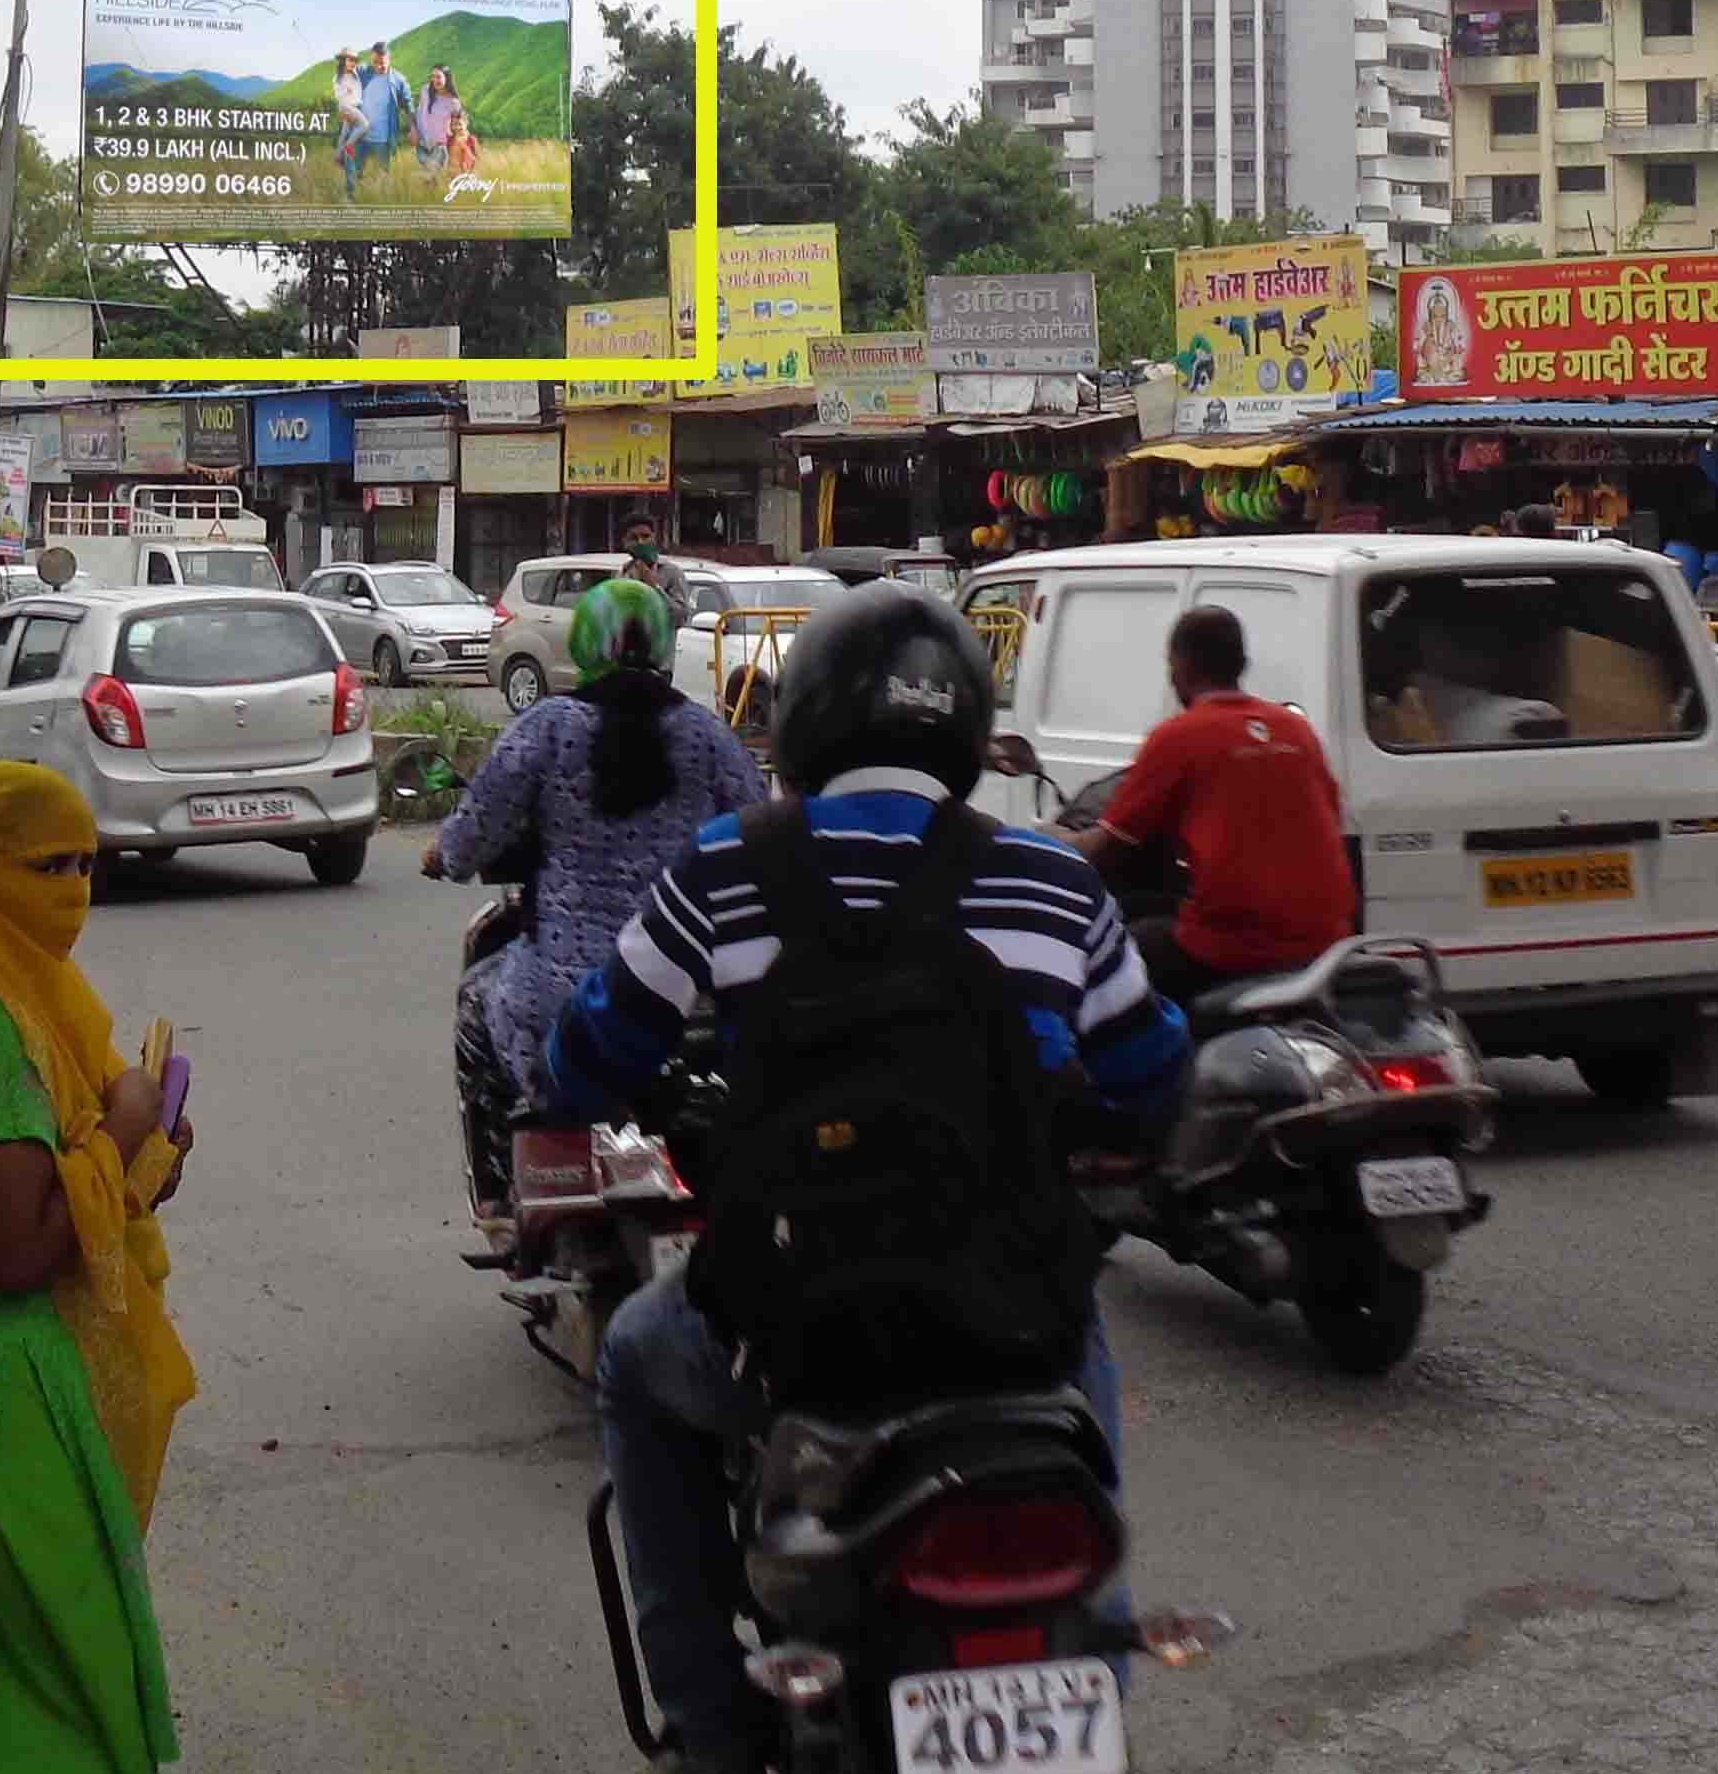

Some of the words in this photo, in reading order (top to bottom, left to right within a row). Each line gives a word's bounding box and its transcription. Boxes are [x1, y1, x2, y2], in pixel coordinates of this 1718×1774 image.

[95, 107, 113, 128] 1,
[118, 107, 131, 126] 2
[136, 107, 151, 126] &
[156, 109, 168, 127] 3
[174, 109, 213, 128] BHK
[218, 110, 305, 131] STARTING
[309, 114, 330, 131] AT
[155, 139, 204, 158] LAKH
[210, 140, 249, 162] (ALL
[255, 142, 307, 164] INCL.)
[126, 173, 206, 194] 98990
[215, 175, 291, 195] 06466
[1475, 288, 1572, 329] उत्तम
[1563, 335, 1633, 384] गादी
[1641, 334, 1707, 381] सेंटर
[197, 405, 233, 429] VINOD
[268, 410, 307, 440] vivo
[912, 1700, 1101, 1768] 4057
